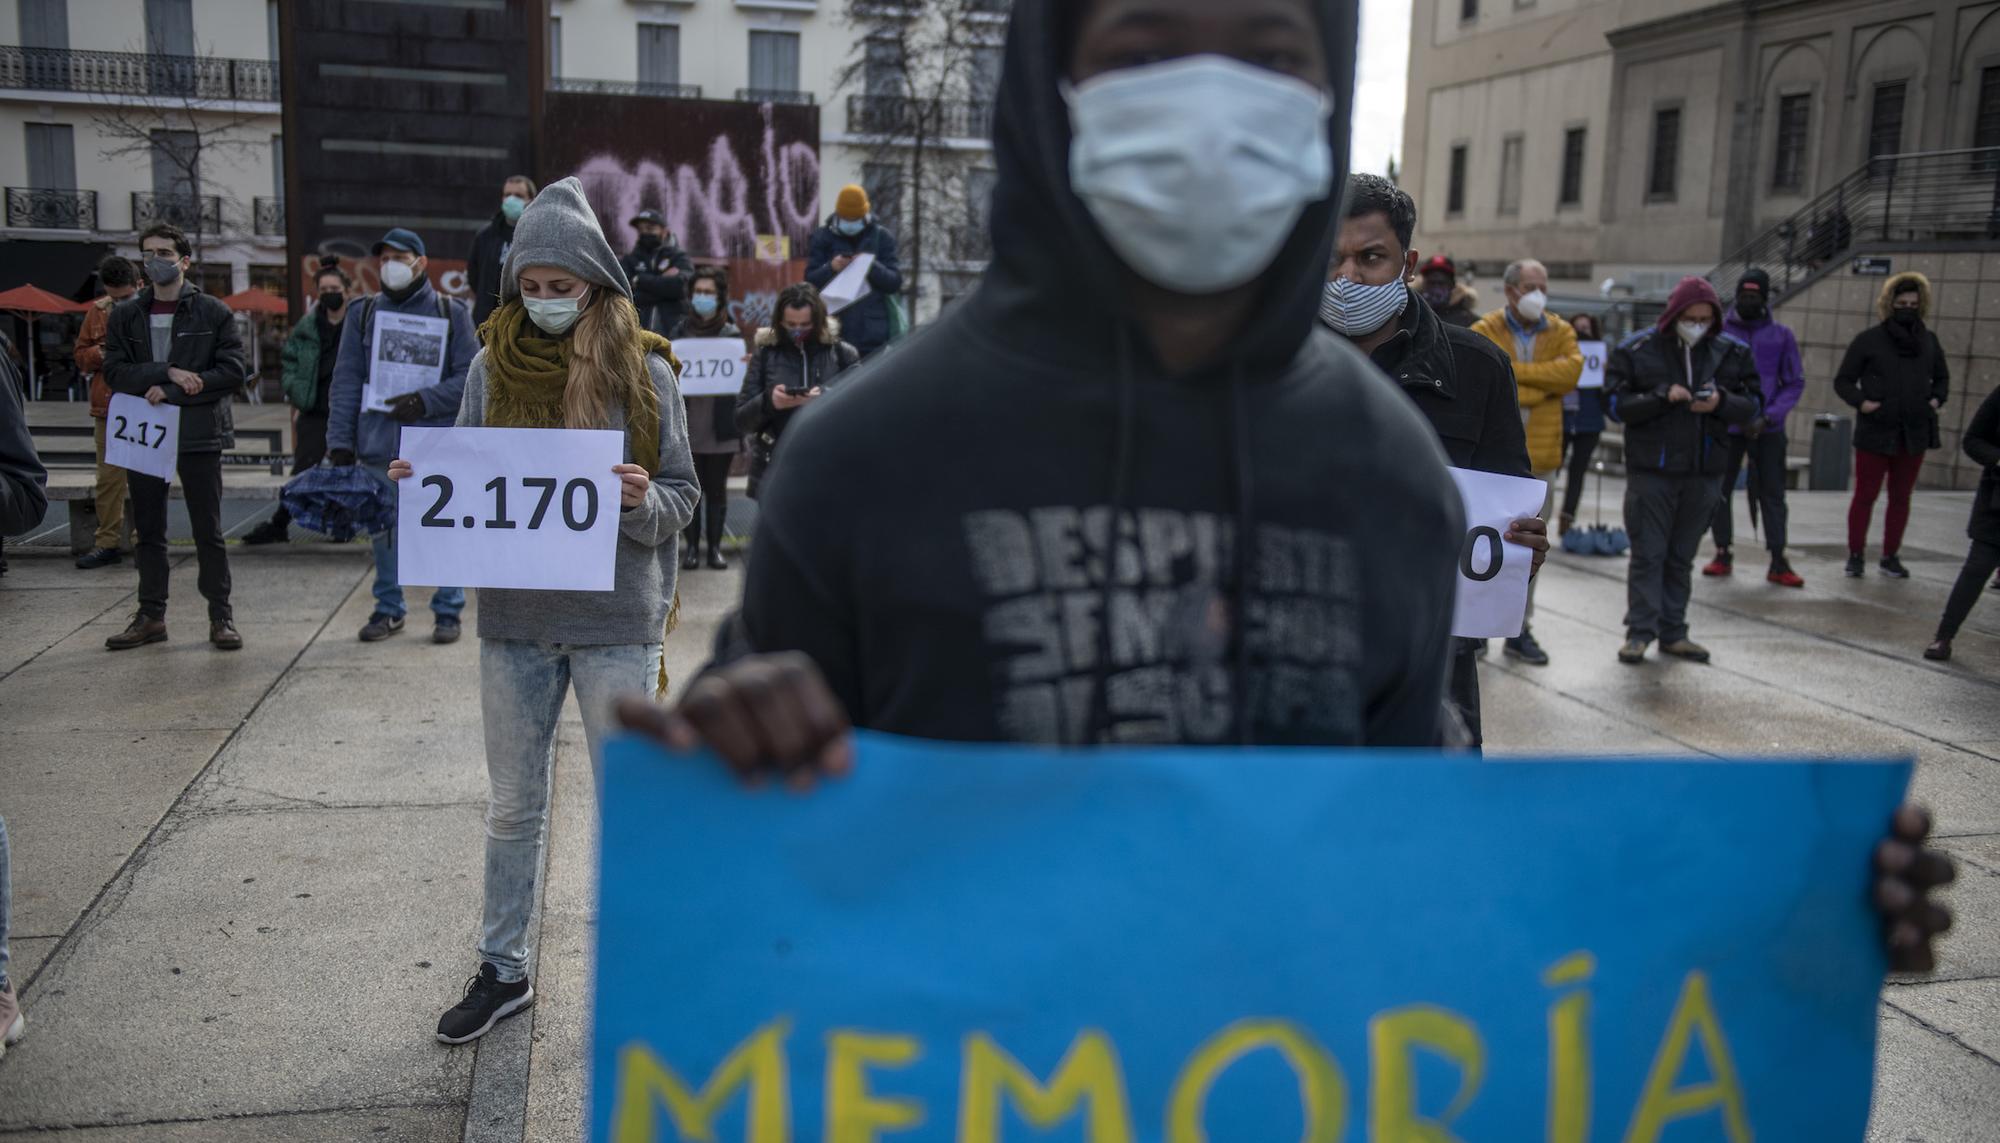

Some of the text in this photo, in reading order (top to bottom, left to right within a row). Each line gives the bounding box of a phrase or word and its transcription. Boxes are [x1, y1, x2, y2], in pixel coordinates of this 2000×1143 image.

[681, 358, 735, 378] 2170
[113, 415, 168, 449] 2.17
[420, 473, 600, 532] 2.170
